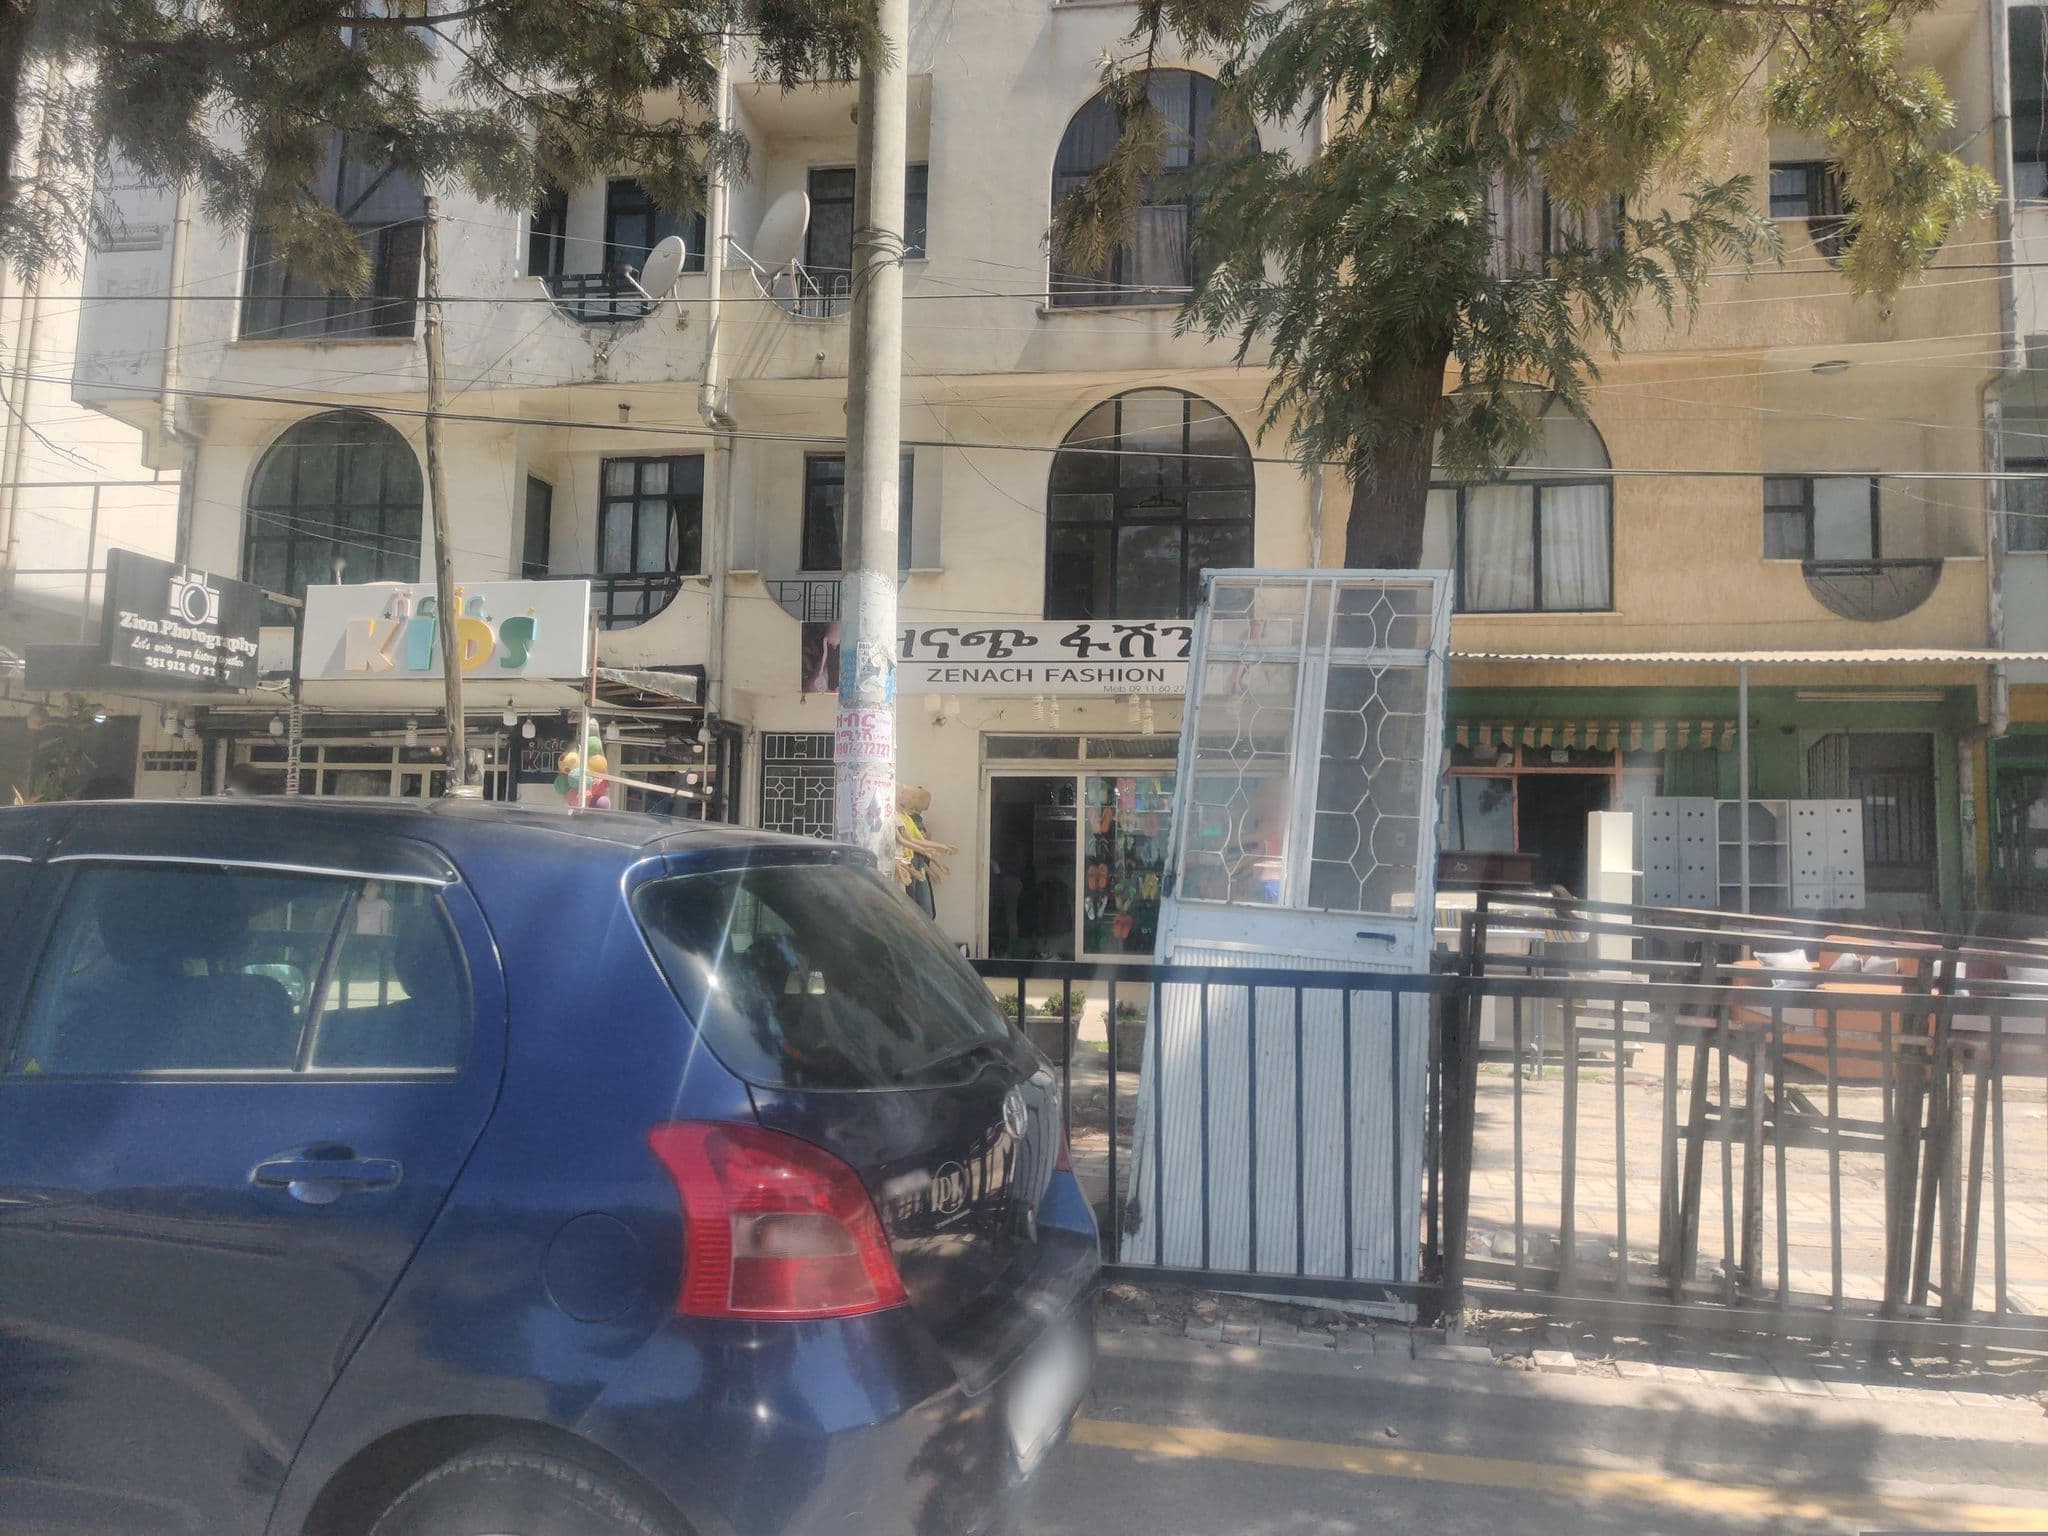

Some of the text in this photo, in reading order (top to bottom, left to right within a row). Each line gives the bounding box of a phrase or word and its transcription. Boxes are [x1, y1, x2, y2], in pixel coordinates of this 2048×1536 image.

[119, 611, 258, 657] Zion Photography
[345, 615, 538, 672] KIDS
[145, 656, 165, 669] 251
[166, 660, 186, 673] 912
[188, 662, 201, 676] 47
[927, 668, 1165, 682] ZENACH FASHION
